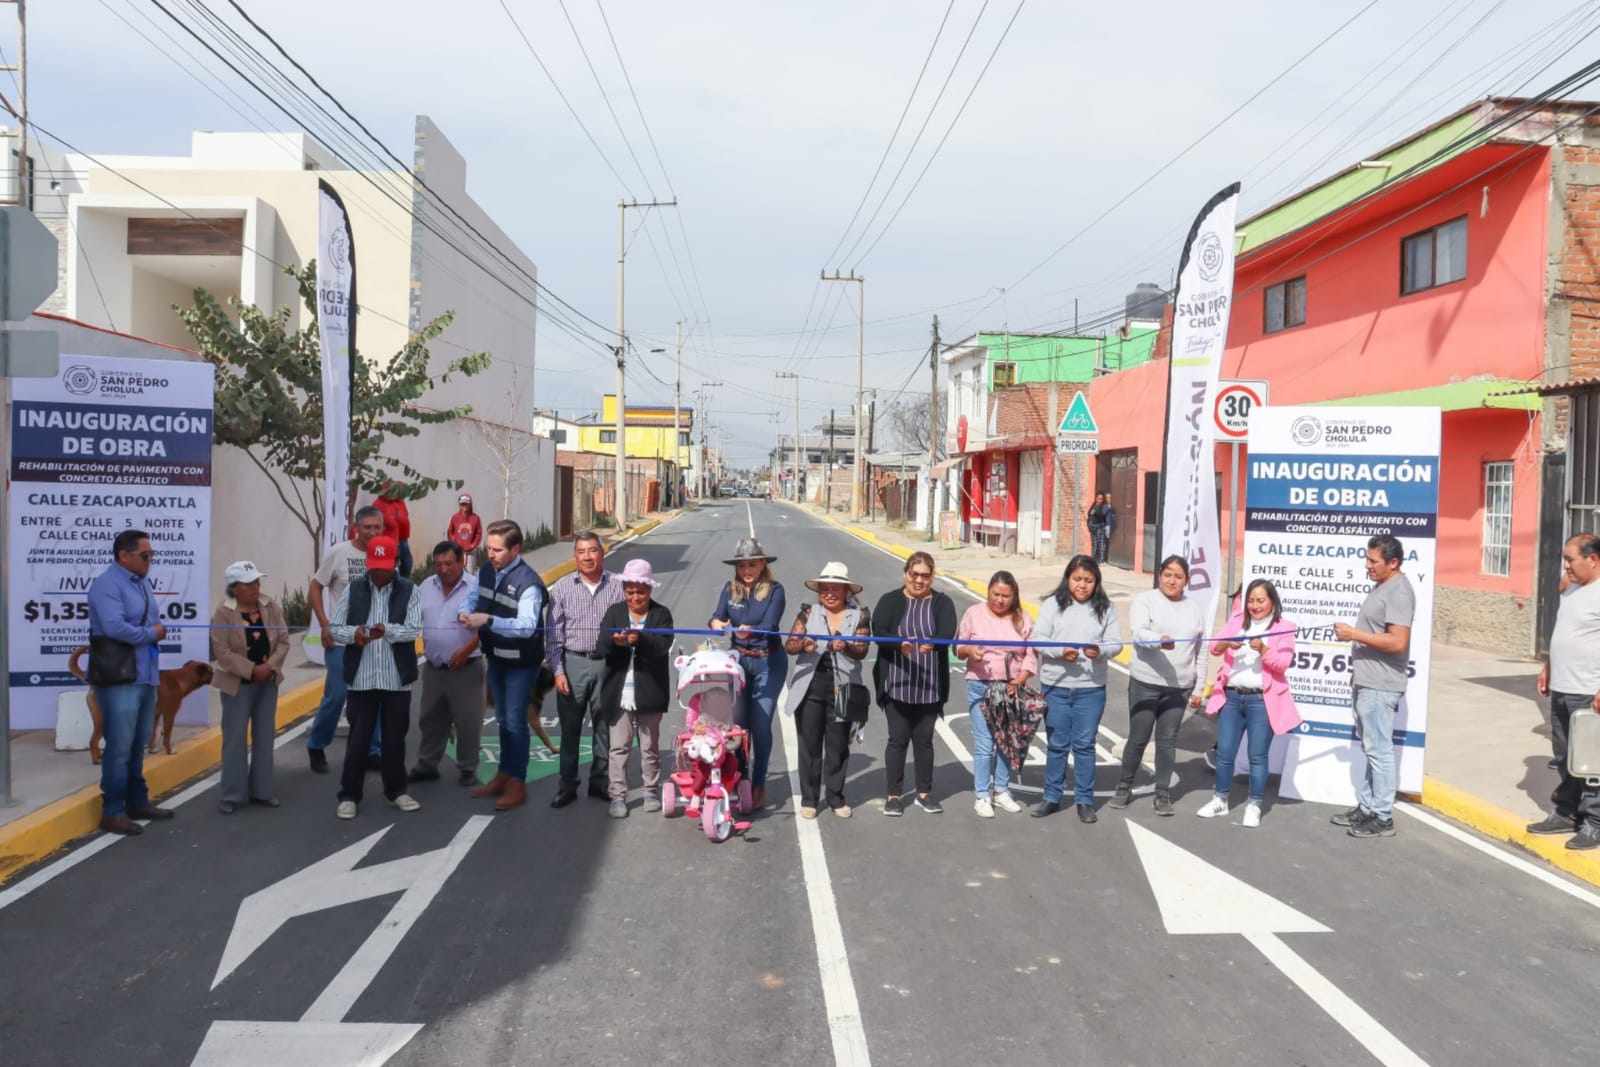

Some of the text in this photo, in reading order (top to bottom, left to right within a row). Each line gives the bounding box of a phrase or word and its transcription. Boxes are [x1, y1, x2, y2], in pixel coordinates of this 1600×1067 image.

[1179, 302, 1205, 317] SAN
[100, 375, 169, 388] SAN PEDRO
[100, 385, 144, 394] CHOLULA
[1224, 396, 1251, 417] 30
[19, 409, 207, 434] INAUGURACIÓN
[1326, 425, 1392, 435] SAN PEDRO
[62, 437, 167, 457] DE OBRA
[1061, 440, 1096, 451] PRIORIDAD
[19, 461, 204, 475] REHABILITACIÓN DE PAVIMENTO CON
[1252, 459, 1432, 483] INAUGURACIÓN
[59, 474, 169, 485] CONCRETO ASFÁLTICO
[28, 493, 197, 509] CALLE ZACAPOAXTLA
[1289, 487, 1389, 508] DE OBRA
[21, 516, 203, 529] ENTRE CALLE 5 NORTE Y
[1251, 511, 1428, 526] REHABILITACIÓN DE PAVIMENTO CON
[39, 530, 78, 540] CALLE
[1286, 524, 1391, 536] CONCRETO ASFÁLTICO
[1258, 543, 1303, 556] CALLE
[1251, 564, 1288, 576] ENTRE
[1299, 567, 1335, 578] CALLE
[1346, 570, 1354, 580] 5
[1417, 573, 1425, 583] Y
[1281, 598, 1317, 606] AUXILIAR
[1336, 601, 1361, 609] MATIA
